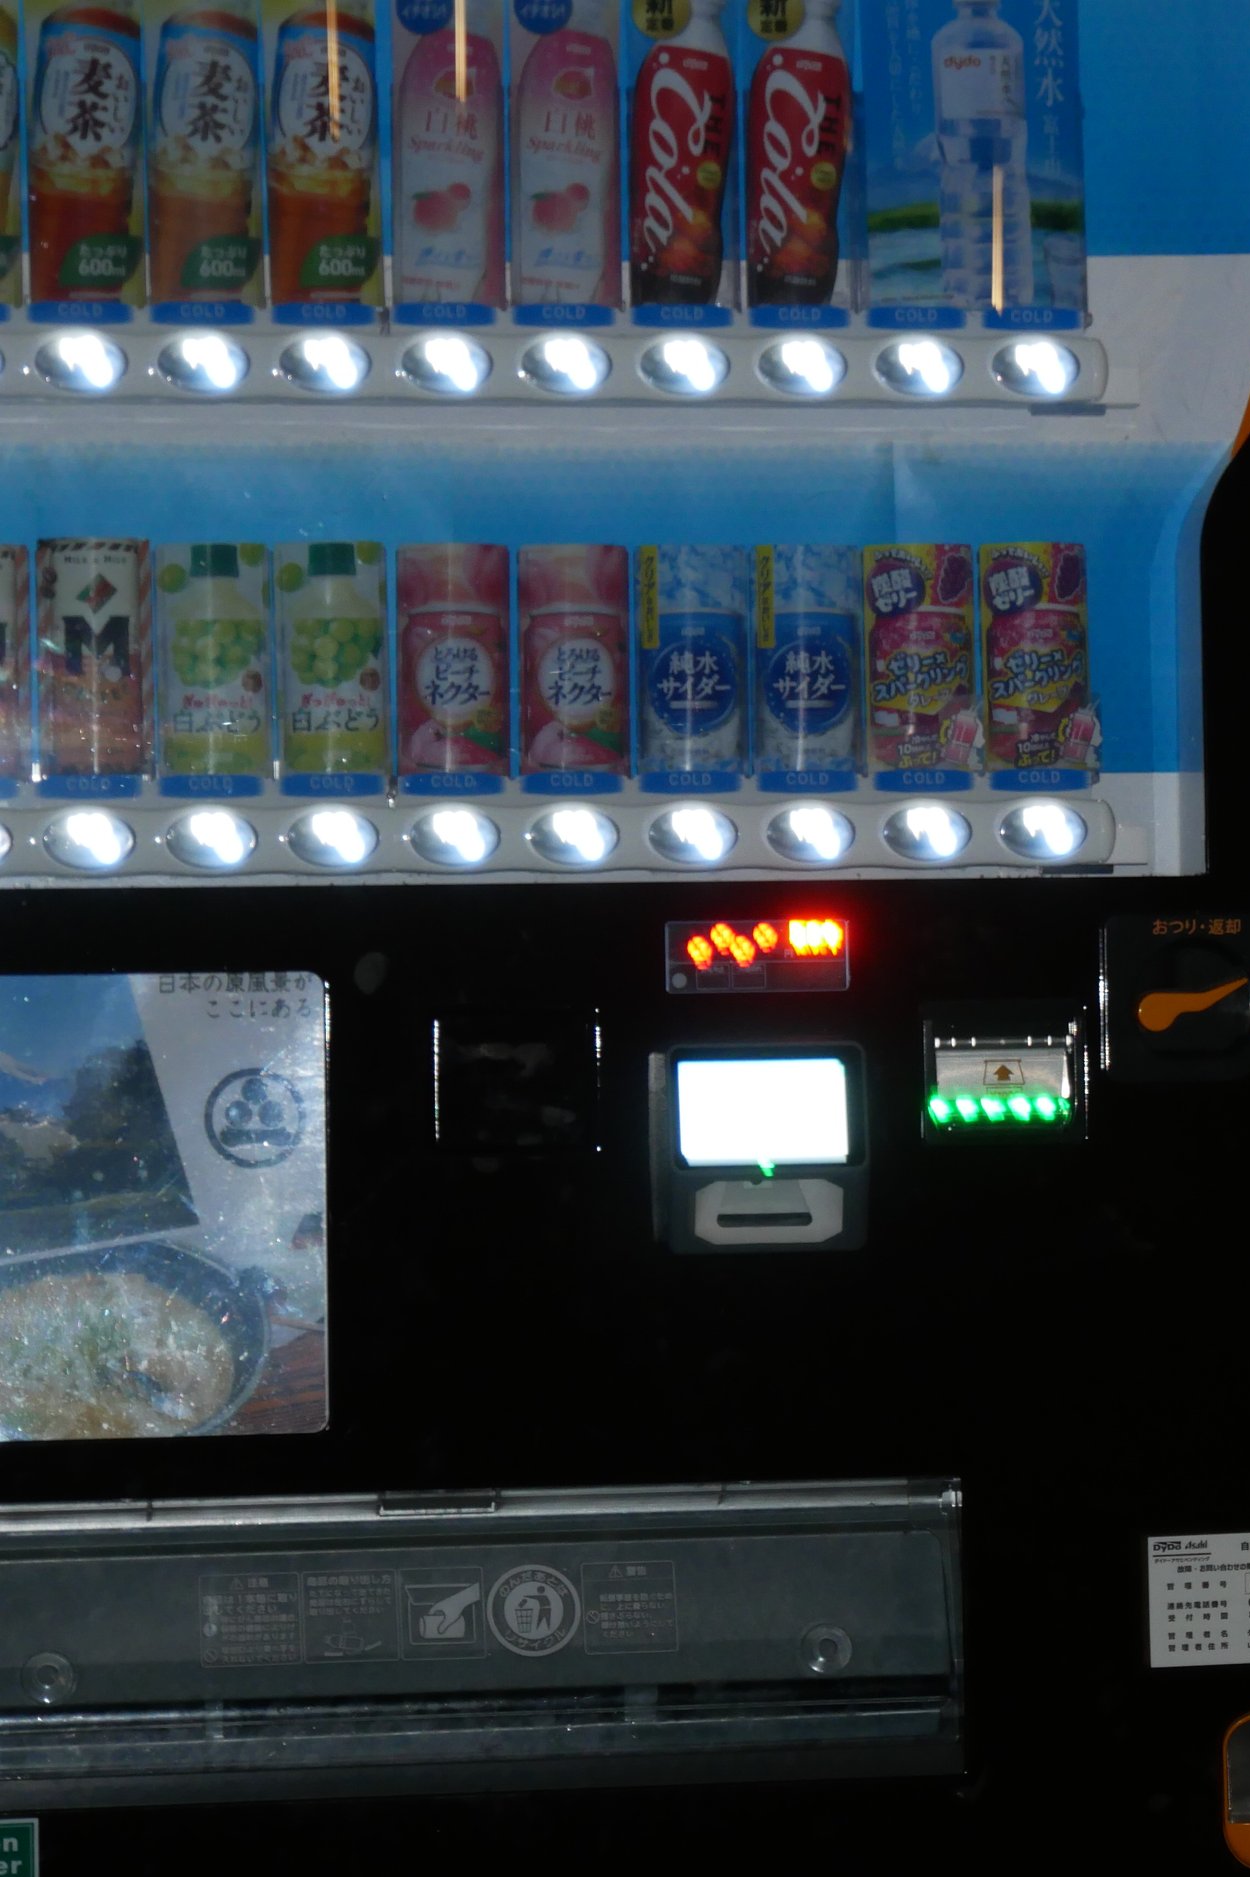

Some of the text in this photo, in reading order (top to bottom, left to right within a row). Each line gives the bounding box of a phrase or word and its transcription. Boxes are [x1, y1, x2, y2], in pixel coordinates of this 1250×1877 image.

[66, 57, 113, 142] 麦茶
[188, 59, 233, 143] 麦茶
[703, 94, 726, 157] THE
[819, 94, 842, 157] THE
[643, 69, 711, 253] Cola
[758, 69, 826, 254] Cola
[58, 303, 102, 318] COLD
[180, 303, 225, 318] COLD
[302, 304, 346, 318] COLD
[423, 306, 466, 320] COLD
[542, 306, 585, 320] COLD
[660, 307, 703, 321] COLD
[779, 307, 821, 321] COLD
[895, 308, 937, 323] COLD
[1011, 308, 1053, 323] COLD
[434, 646, 479, 662] とろける
[669, 650, 719, 674] 純水
[785, 650, 834, 674] 純水
[435, 664, 480, 682] ピーチ
[874, 655, 968, 700] スパークリング
[993, 654, 1083, 699] スパークリング
[425, 681, 490, 706] ネクター
[548, 682, 612, 706] ネクター
[657, 675, 732, 700] サイダー
[773, 676, 846, 700] サイダー
[173, 708, 262, 733] 白ぶどう
[292, 707, 379, 732] 白ぶどう
[66, 776, 110, 791] COLD
[189, 776, 233, 791] COLD
[310, 776, 354, 791] COLD
[431, 774, 474, 787] COLD
[551, 774, 594, 787] COLD
[669, 772, 711, 786] COLD
[786, 772, 829, 786] COLD
[903, 771, 946, 785] COLD
[1018, 770, 1061, 784] COLD
[1152, 918, 1242, 936] おつり・返却
[159, 973, 314, 995] 日本の原風景が
[207, 998, 312, 1019] ここにある
[1153, 1540, 1208, 1553] DyDo Asahi
[499, 1569, 571, 1598] のんだあとは
[503, 1627, 567, 1650] リサイクル
